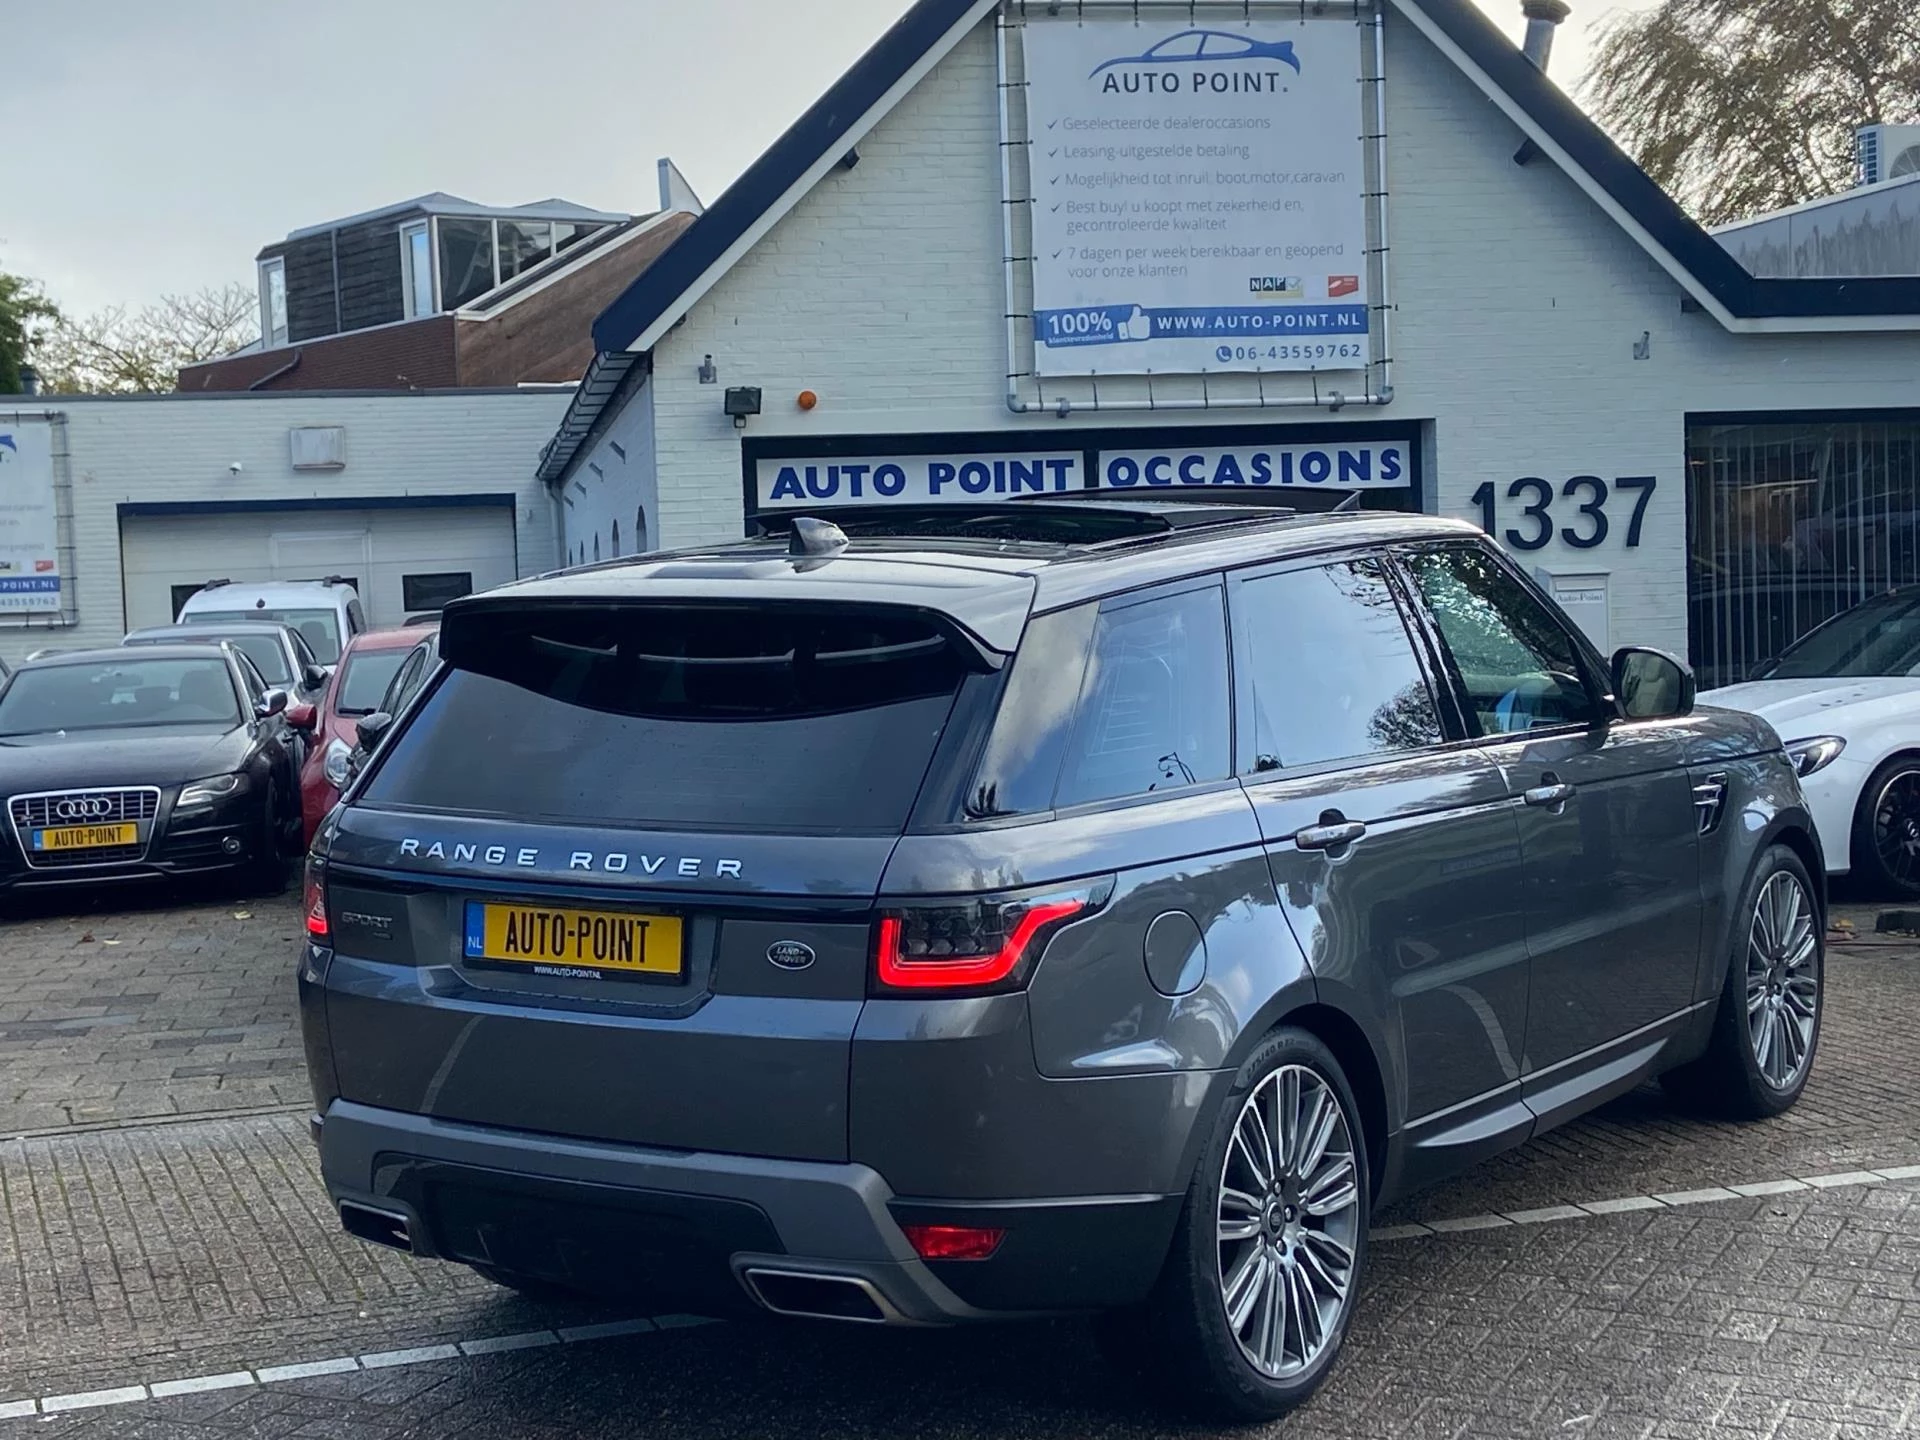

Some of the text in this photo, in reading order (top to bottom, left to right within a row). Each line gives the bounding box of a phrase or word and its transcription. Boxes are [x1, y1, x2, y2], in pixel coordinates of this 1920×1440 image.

[1102, 72, 1179, 93] AUTO
[1063, 114, 1271, 131] Geselecteerde dealeroccasions
[1196, 143, 1250, 160] betaling
[1065, 171, 1149, 189] Mogelijkheid
[1153, 172, 1171, 185] tot
[1066, 200, 1096, 214] Best
[1132, 202, 1140, 213] u
[1145, 199, 1182, 215] koopt
[1187, 200, 1212, 212] met
[1216, 198, 1281, 212] zekerheid
[1067, 217, 1227, 236] gecontroleerde kwaliteit
[1069, 243, 1344, 263] 7 dagen per week bereikbaar en geopend
[1068, 263, 1188, 279] voor onze klanten
[1251, 277, 1286, 291] NAP
[1048, 311, 1112, 335] 100%
[1157, 313, 1361, 330] WWW.AUTO-POINT.NL
[1236, 344, 1361, 360] 06-43559762
[769, 448, 1402, 500] AUTO POINT OCCASIONS
[1471, 475, 1657, 550] 1337
[54, 827, 122, 847] AUTO-POINT
[400, 838, 743, 879] RANGE ROVER
[467, 911, 650, 963] NL AUTO-POINT
